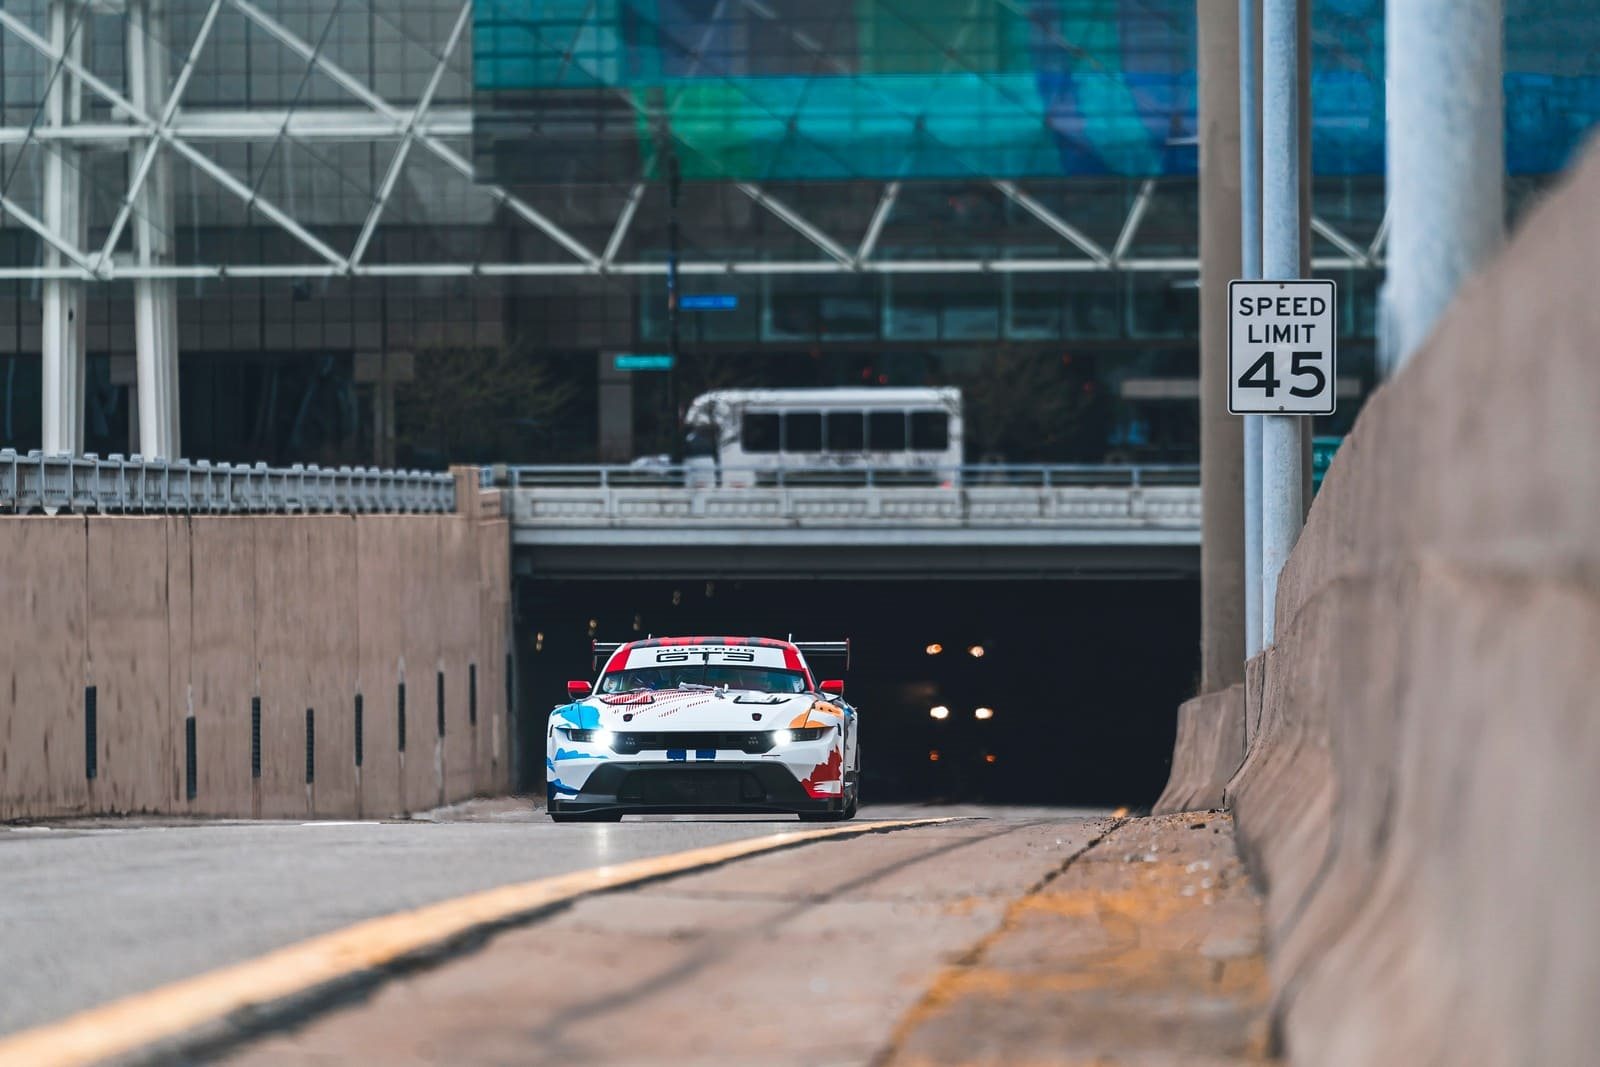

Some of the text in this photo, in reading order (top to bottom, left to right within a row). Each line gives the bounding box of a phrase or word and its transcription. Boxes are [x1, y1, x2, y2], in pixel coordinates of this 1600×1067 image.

[1238, 297, 1326, 316] SPEED
[1248, 324, 1316, 344] LIMIT
[1237, 351, 1326, 398] 45
[656, 651, 755, 663] GT3
